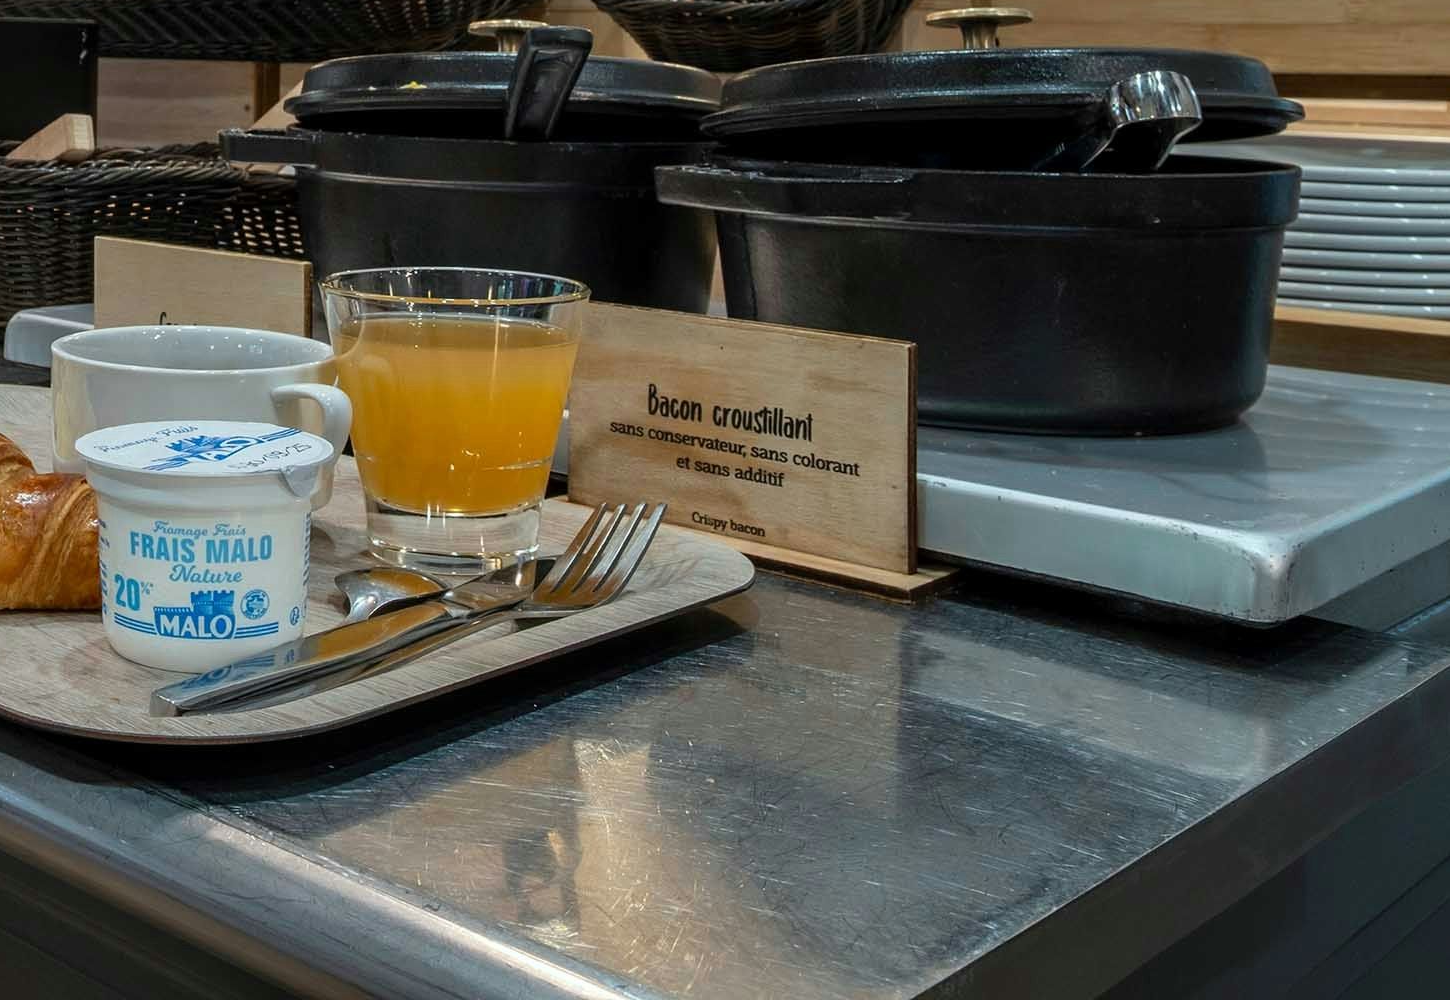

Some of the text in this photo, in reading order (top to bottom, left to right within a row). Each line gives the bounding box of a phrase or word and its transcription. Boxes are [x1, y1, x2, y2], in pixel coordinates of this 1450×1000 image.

[647, 383, 814, 442] Bacon croustillant
[609, 420, 861, 477] sans conservateur, sans colorant
[676, 455, 786, 488] et sans additif
[152, 519, 247, 539] Fromage Frais
[691, 511, 766, 538] Crispy bacon
[129, 531, 196, 564] FRAIS
[205, 534, 273, 564] MALO
[169, 563, 244, 584] Nature
[159, 614, 233, 639] MALO
